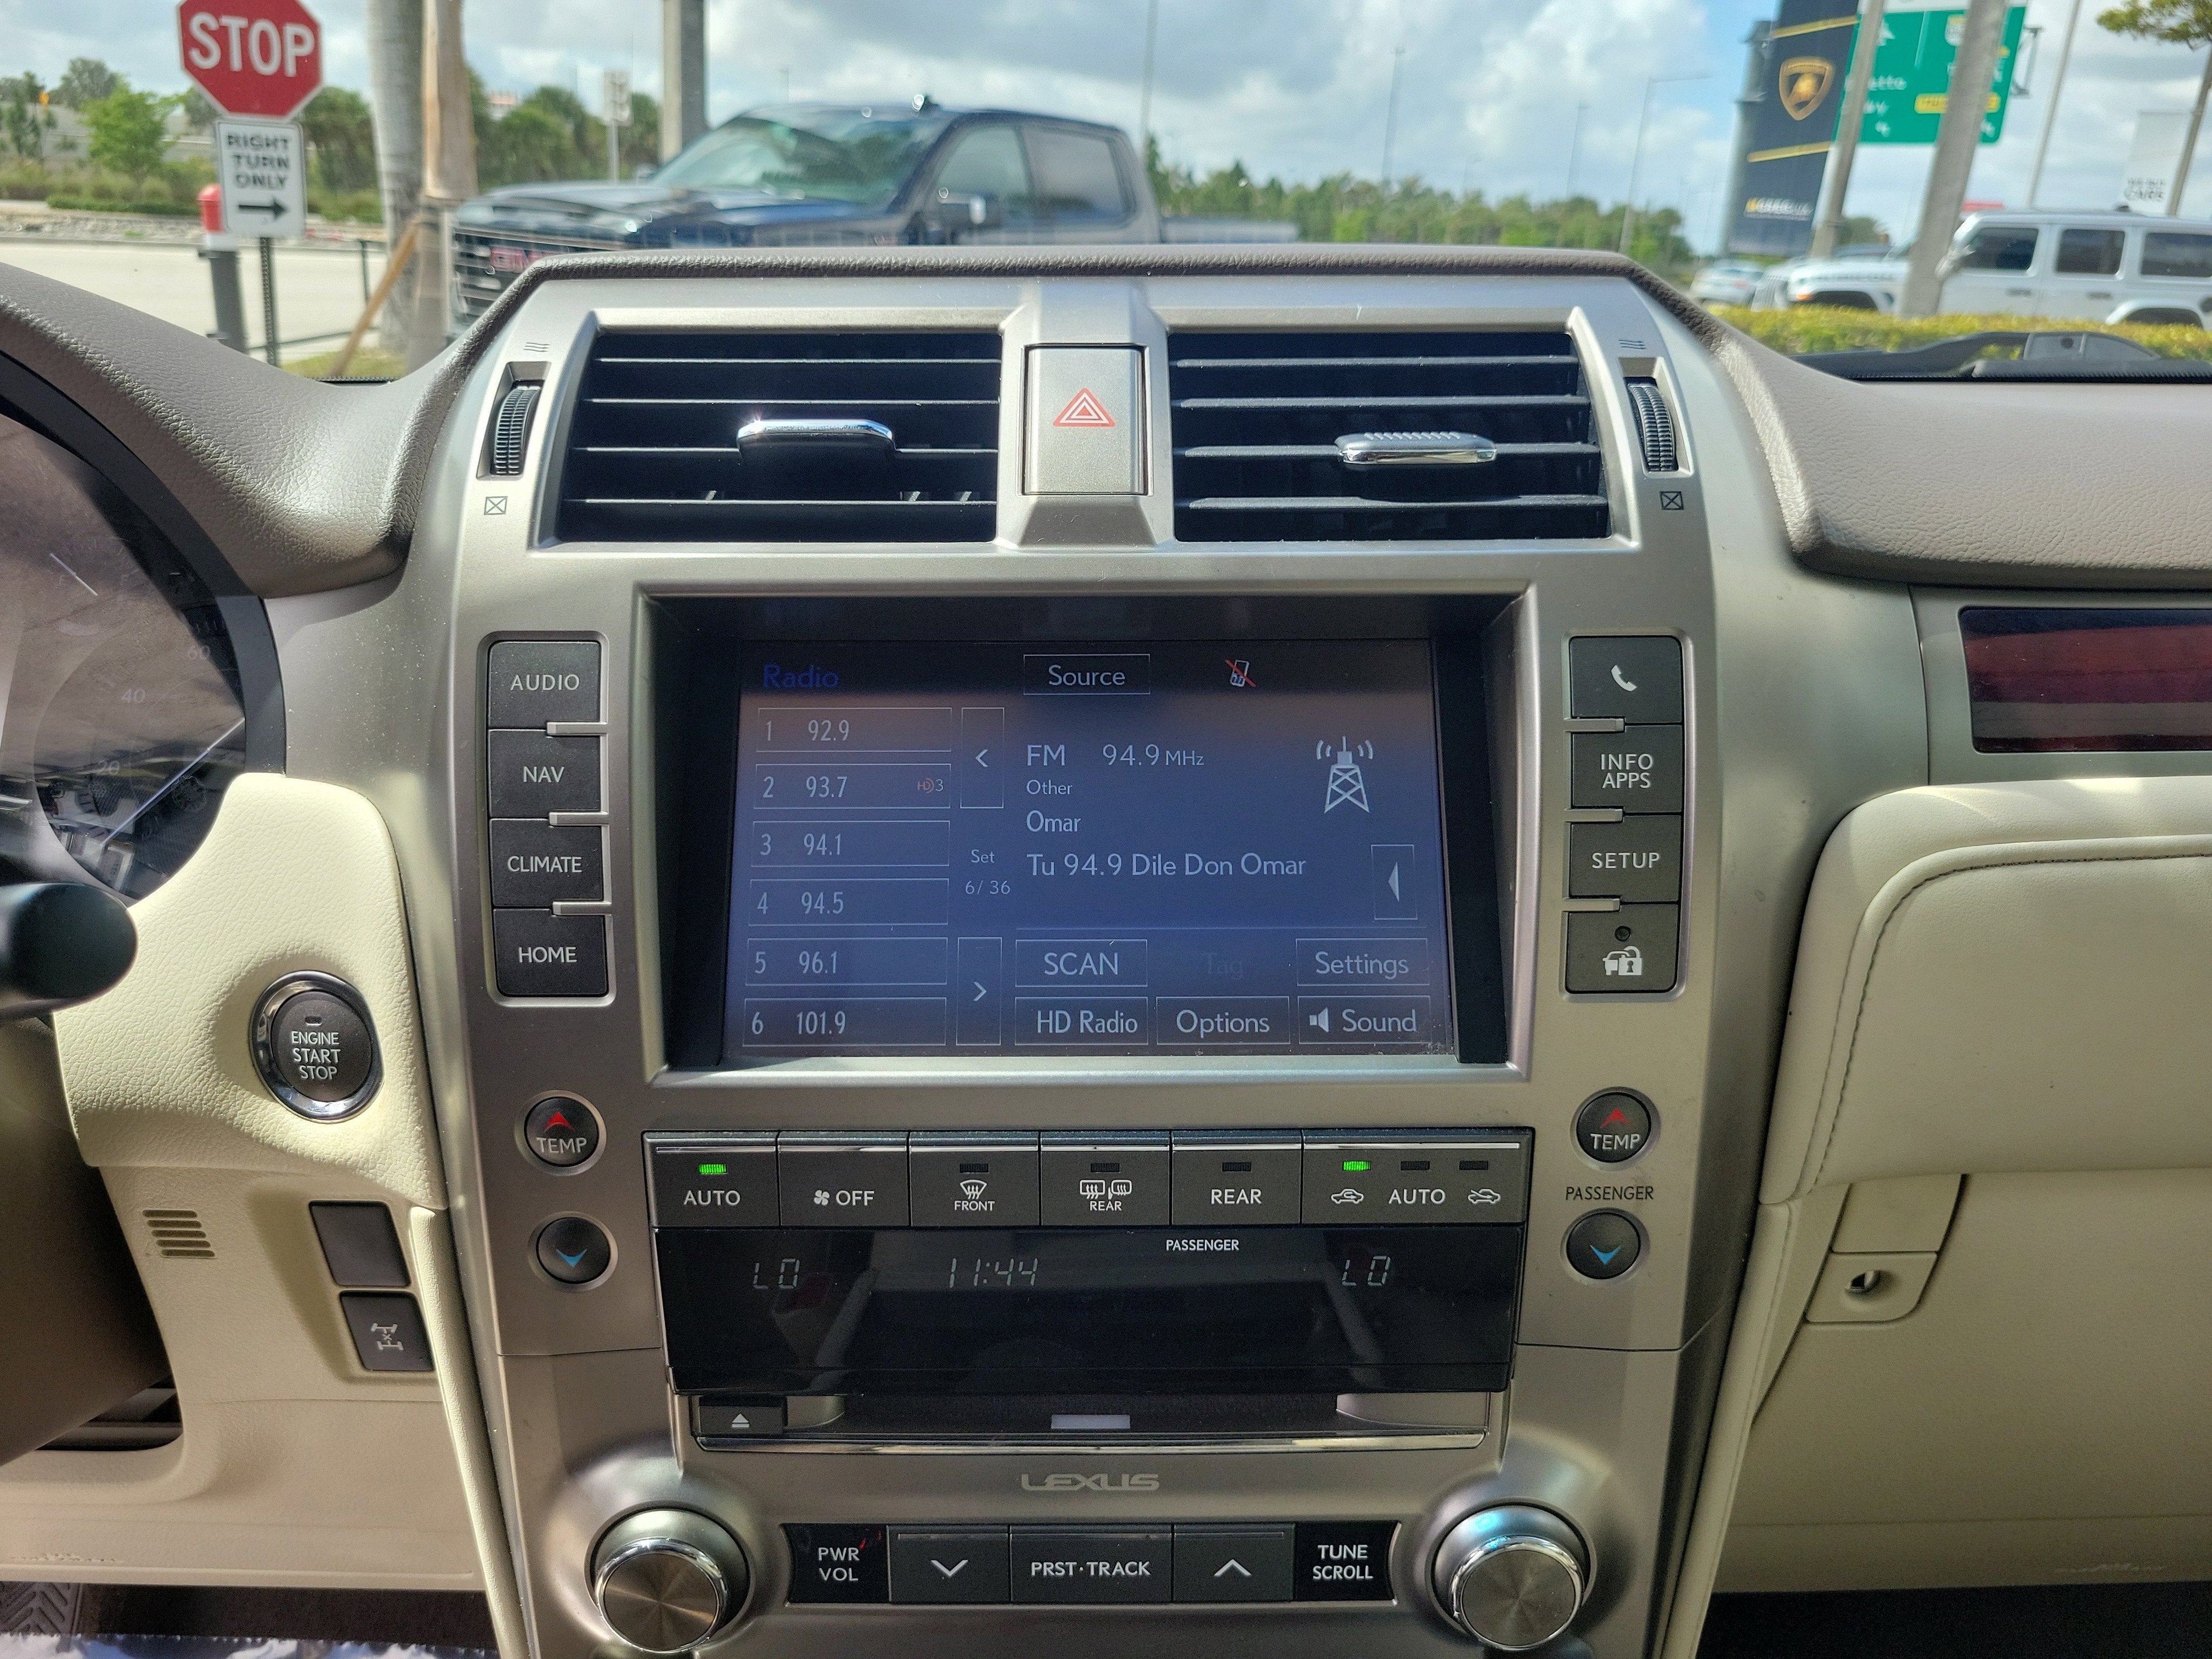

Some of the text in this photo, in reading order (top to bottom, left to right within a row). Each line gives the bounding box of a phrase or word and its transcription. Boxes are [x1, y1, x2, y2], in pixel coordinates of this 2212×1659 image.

[188, 12, 315, 77] STOP
[227, 133, 289, 150] RIGHT
[232, 154, 289, 169] TURN
[235, 173, 287, 190] ONLY
[511, 674, 580, 691] AUDIO
[763, 664, 840, 689] Radio
[1048, 664, 1126, 687] Source
[121, 687, 146, 704] 40
[765, 719, 850, 742] 1 92.9
[1026, 744, 1205, 766] FM 94.9 MHz
[1600, 753, 1654, 770] INFO
[523, 766, 565, 783] NAV
[1602, 772, 1651, 789] APPS
[763, 776, 775, 799] 2
[805, 776, 848, 799] 93.7
[1026, 780, 1073, 795] Other
[1026, 810, 1081, 833] Omar
[760, 833, 842, 856] 3 94.1
[507, 856, 583, 873] CLIMATE
[970, 850, 995, 864] Set
[1027, 853, 1307, 876] Tu 94.9 Dile Don Omar
[1592, 852, 1661, 869] SETUP
[757, 891, 844, 915] 4 94.5
[518, 946, 577, 963] HOME
[754, 951, 838, 974] 5 96.1
[1043, 952, 1119, 975] SCAN
[1315, 951, 1409, 979] Settings
[752, 1011, 847, 1035] 6 101.9
[1037, 1010, 1138, 1034] HD Radio
[1176, 1009, 1270, 1037] Options
[1342, 1008, 1417, 1032] Sound
[291, 1030, 340, 1046] ENGINE
[293, 1048, 341, 1063] START
[299, 1065, 338, 1081] STOP
[536, 1137, 588, 1154] TEMP
[1590, 1133, 1641, 1150] TEMP
[684, 1189, 741, 1206] AUTO
[836, 1189, 875, 1206] OFF
[1210, 1188, 1262, 1205] REAR
[1389, 1188, 1446, 1205] AUTO
[1565, 1186, 1654, 1200] PASSENGER
[954, 1200, 996, 1211] FRONT
[1089, 1200, 1123, 1211] REAR
[1166, 1239, 1240, 1251] PASSENGER
[753, 1257, 801, 1289] LO
[949, 1257, 1039, 1289] 11:44
[1341, 1255, 1391, 1287] LO
[1020, 1472, 1160, 1492] LEXUS
[817, 1547, 861, 1561] PWR
[1317, 1544, 1369, 1559] TUNE
[818, 1567, 859, 1582] VOL
[1312, 1565, 1374, 1581] SCROLL
